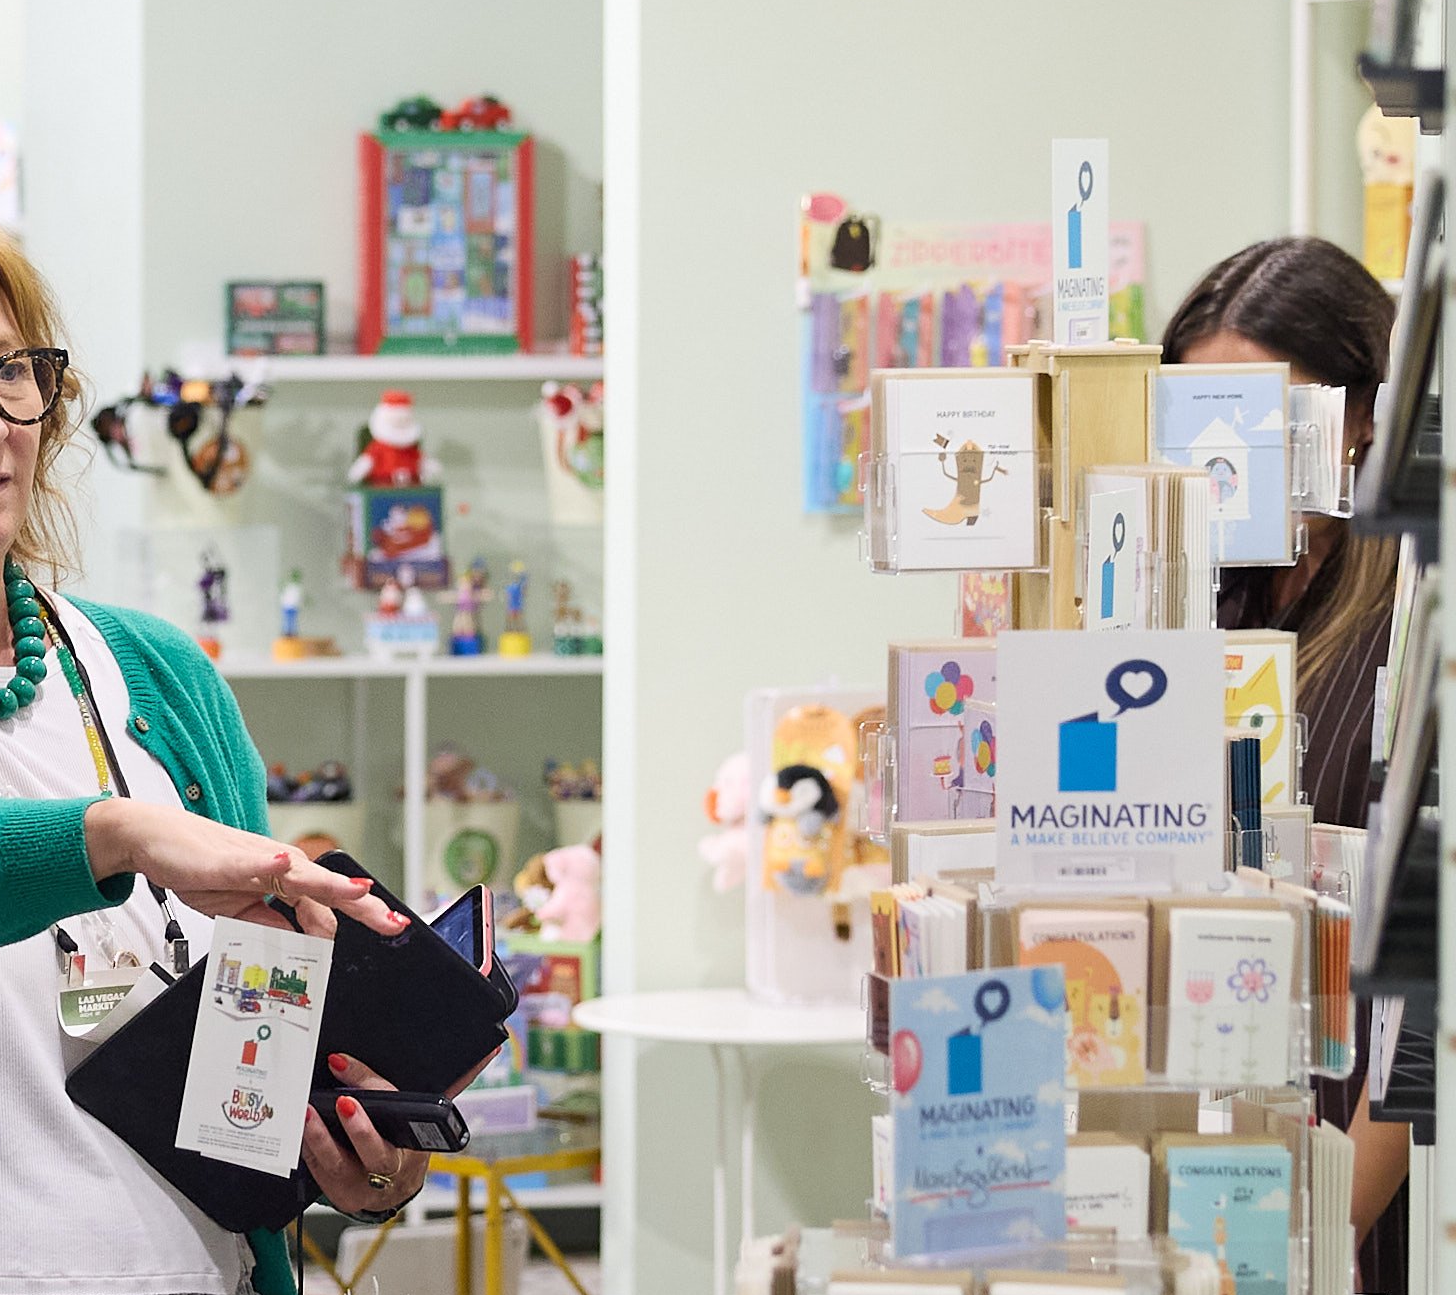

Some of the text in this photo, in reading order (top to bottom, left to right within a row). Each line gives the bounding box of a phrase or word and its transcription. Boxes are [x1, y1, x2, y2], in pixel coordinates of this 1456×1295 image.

[1057, 277, 1106, 300] MAGINATING
[936, 410, 996, 419] HAPPY BIRTHDAY
[1010, 803, 1209, 829] MAGINATING
[1010, 830, 1207, 847] A MAKE BELIEVE COMPANY
[1031, 930, 1136, 944] CONGRATULATIONS
[78, 992, 126, 1005] LAS VEGAS
[78, 1001, 115, 1014] MARKET
[231, 1088, 265, 1110] BUSY
[919, 1094, 1036, 1126] MAGINATING
[1178, 1164, 1283, 1179] CONGRATULATIONS
